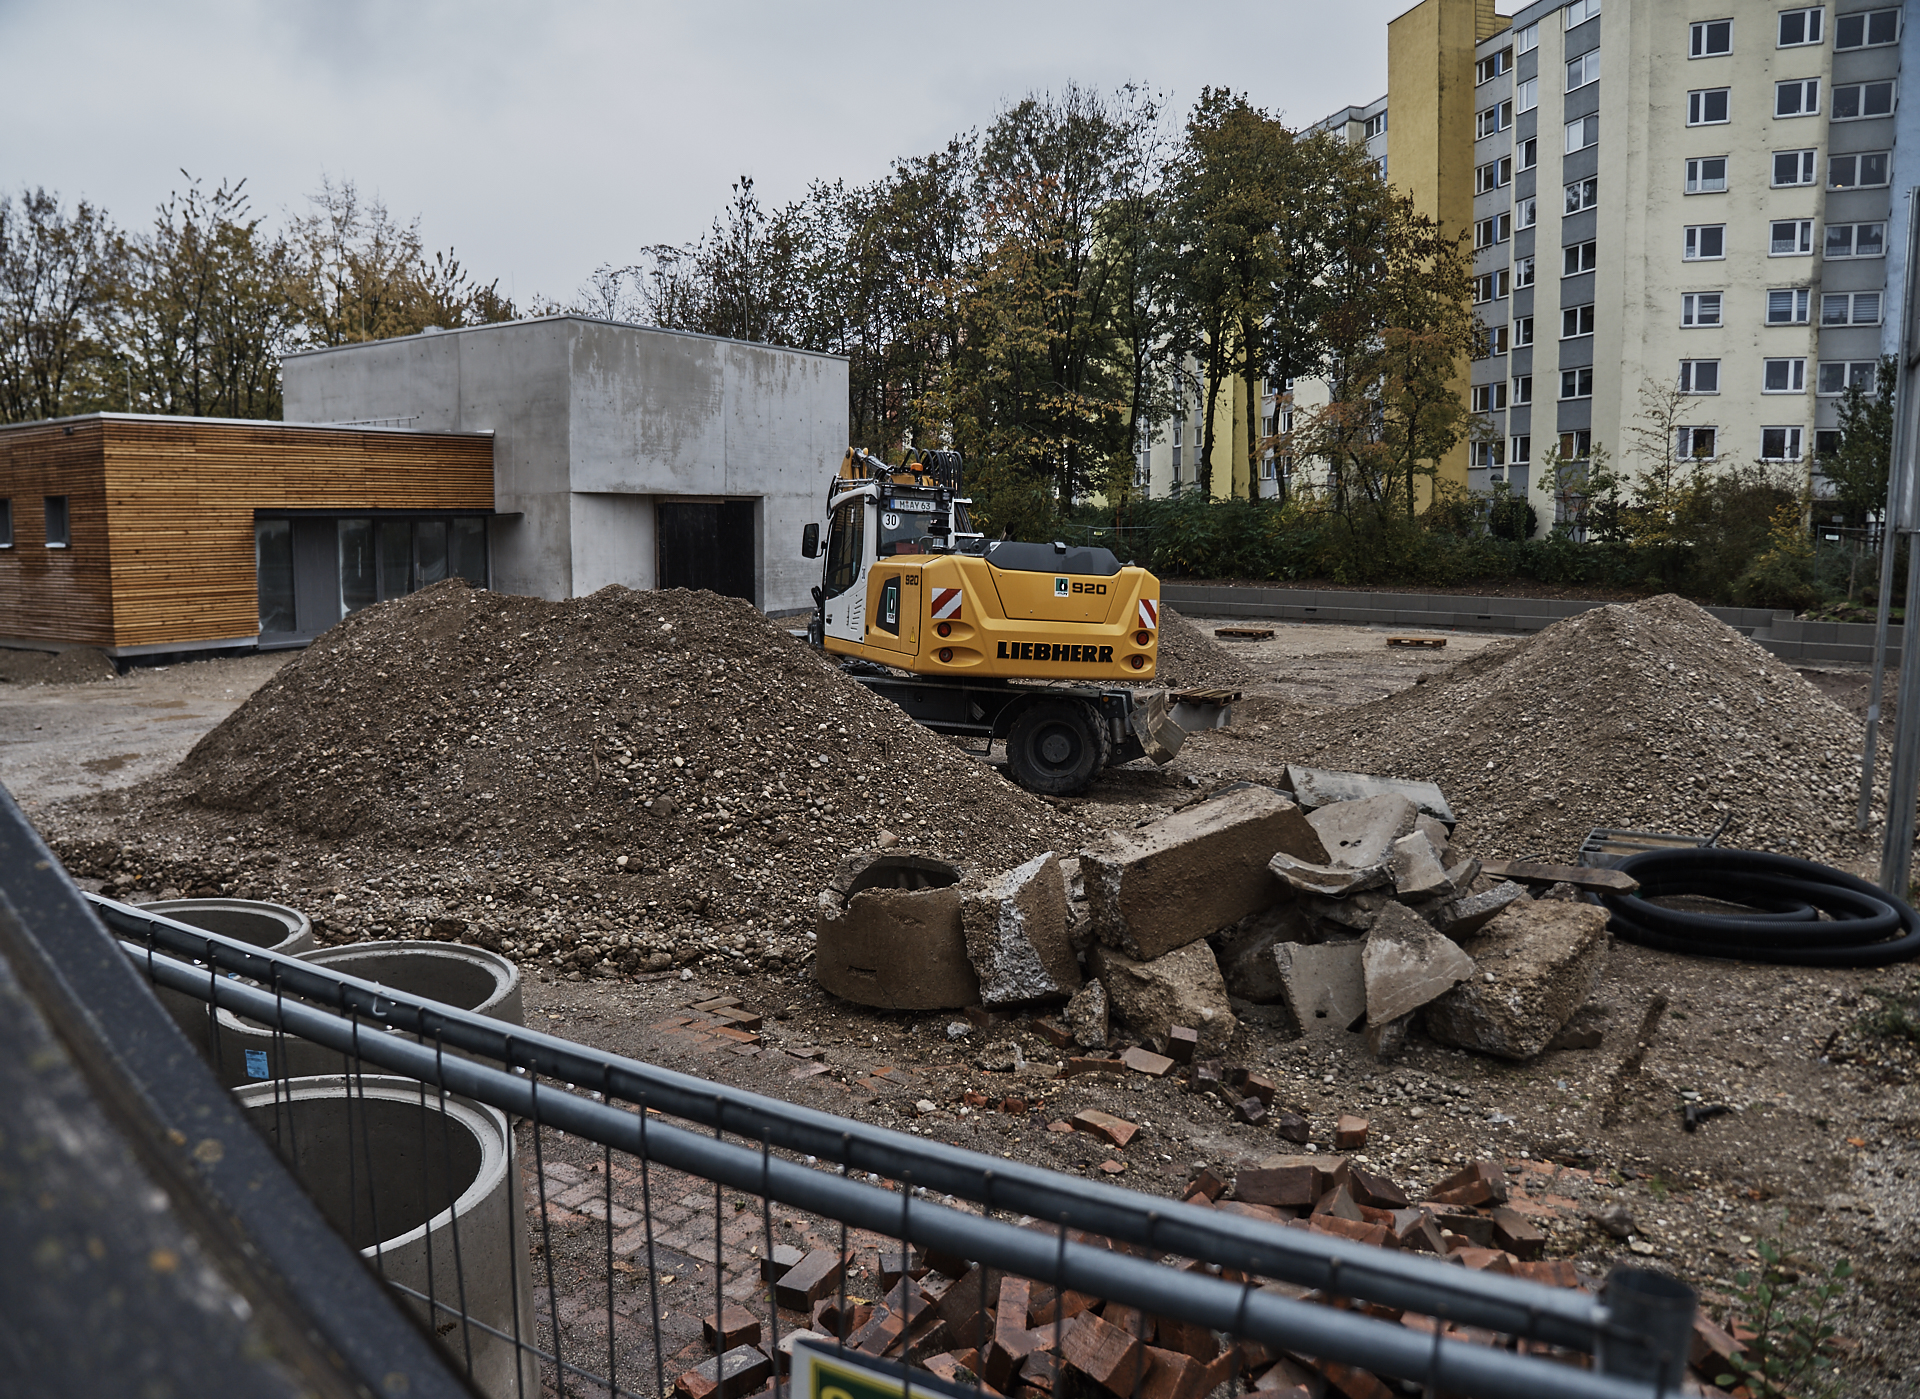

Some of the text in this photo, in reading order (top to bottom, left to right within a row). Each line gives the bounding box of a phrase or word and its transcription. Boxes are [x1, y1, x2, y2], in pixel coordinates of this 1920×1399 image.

[900, 500, 931, 510] M AY 63
[885, 514, 896, 526] 30
[905, 575, 918, 586] 920
[1072, 582, 1107, 595] 920
[996, 641, 1114, 663] LIEBHERR
